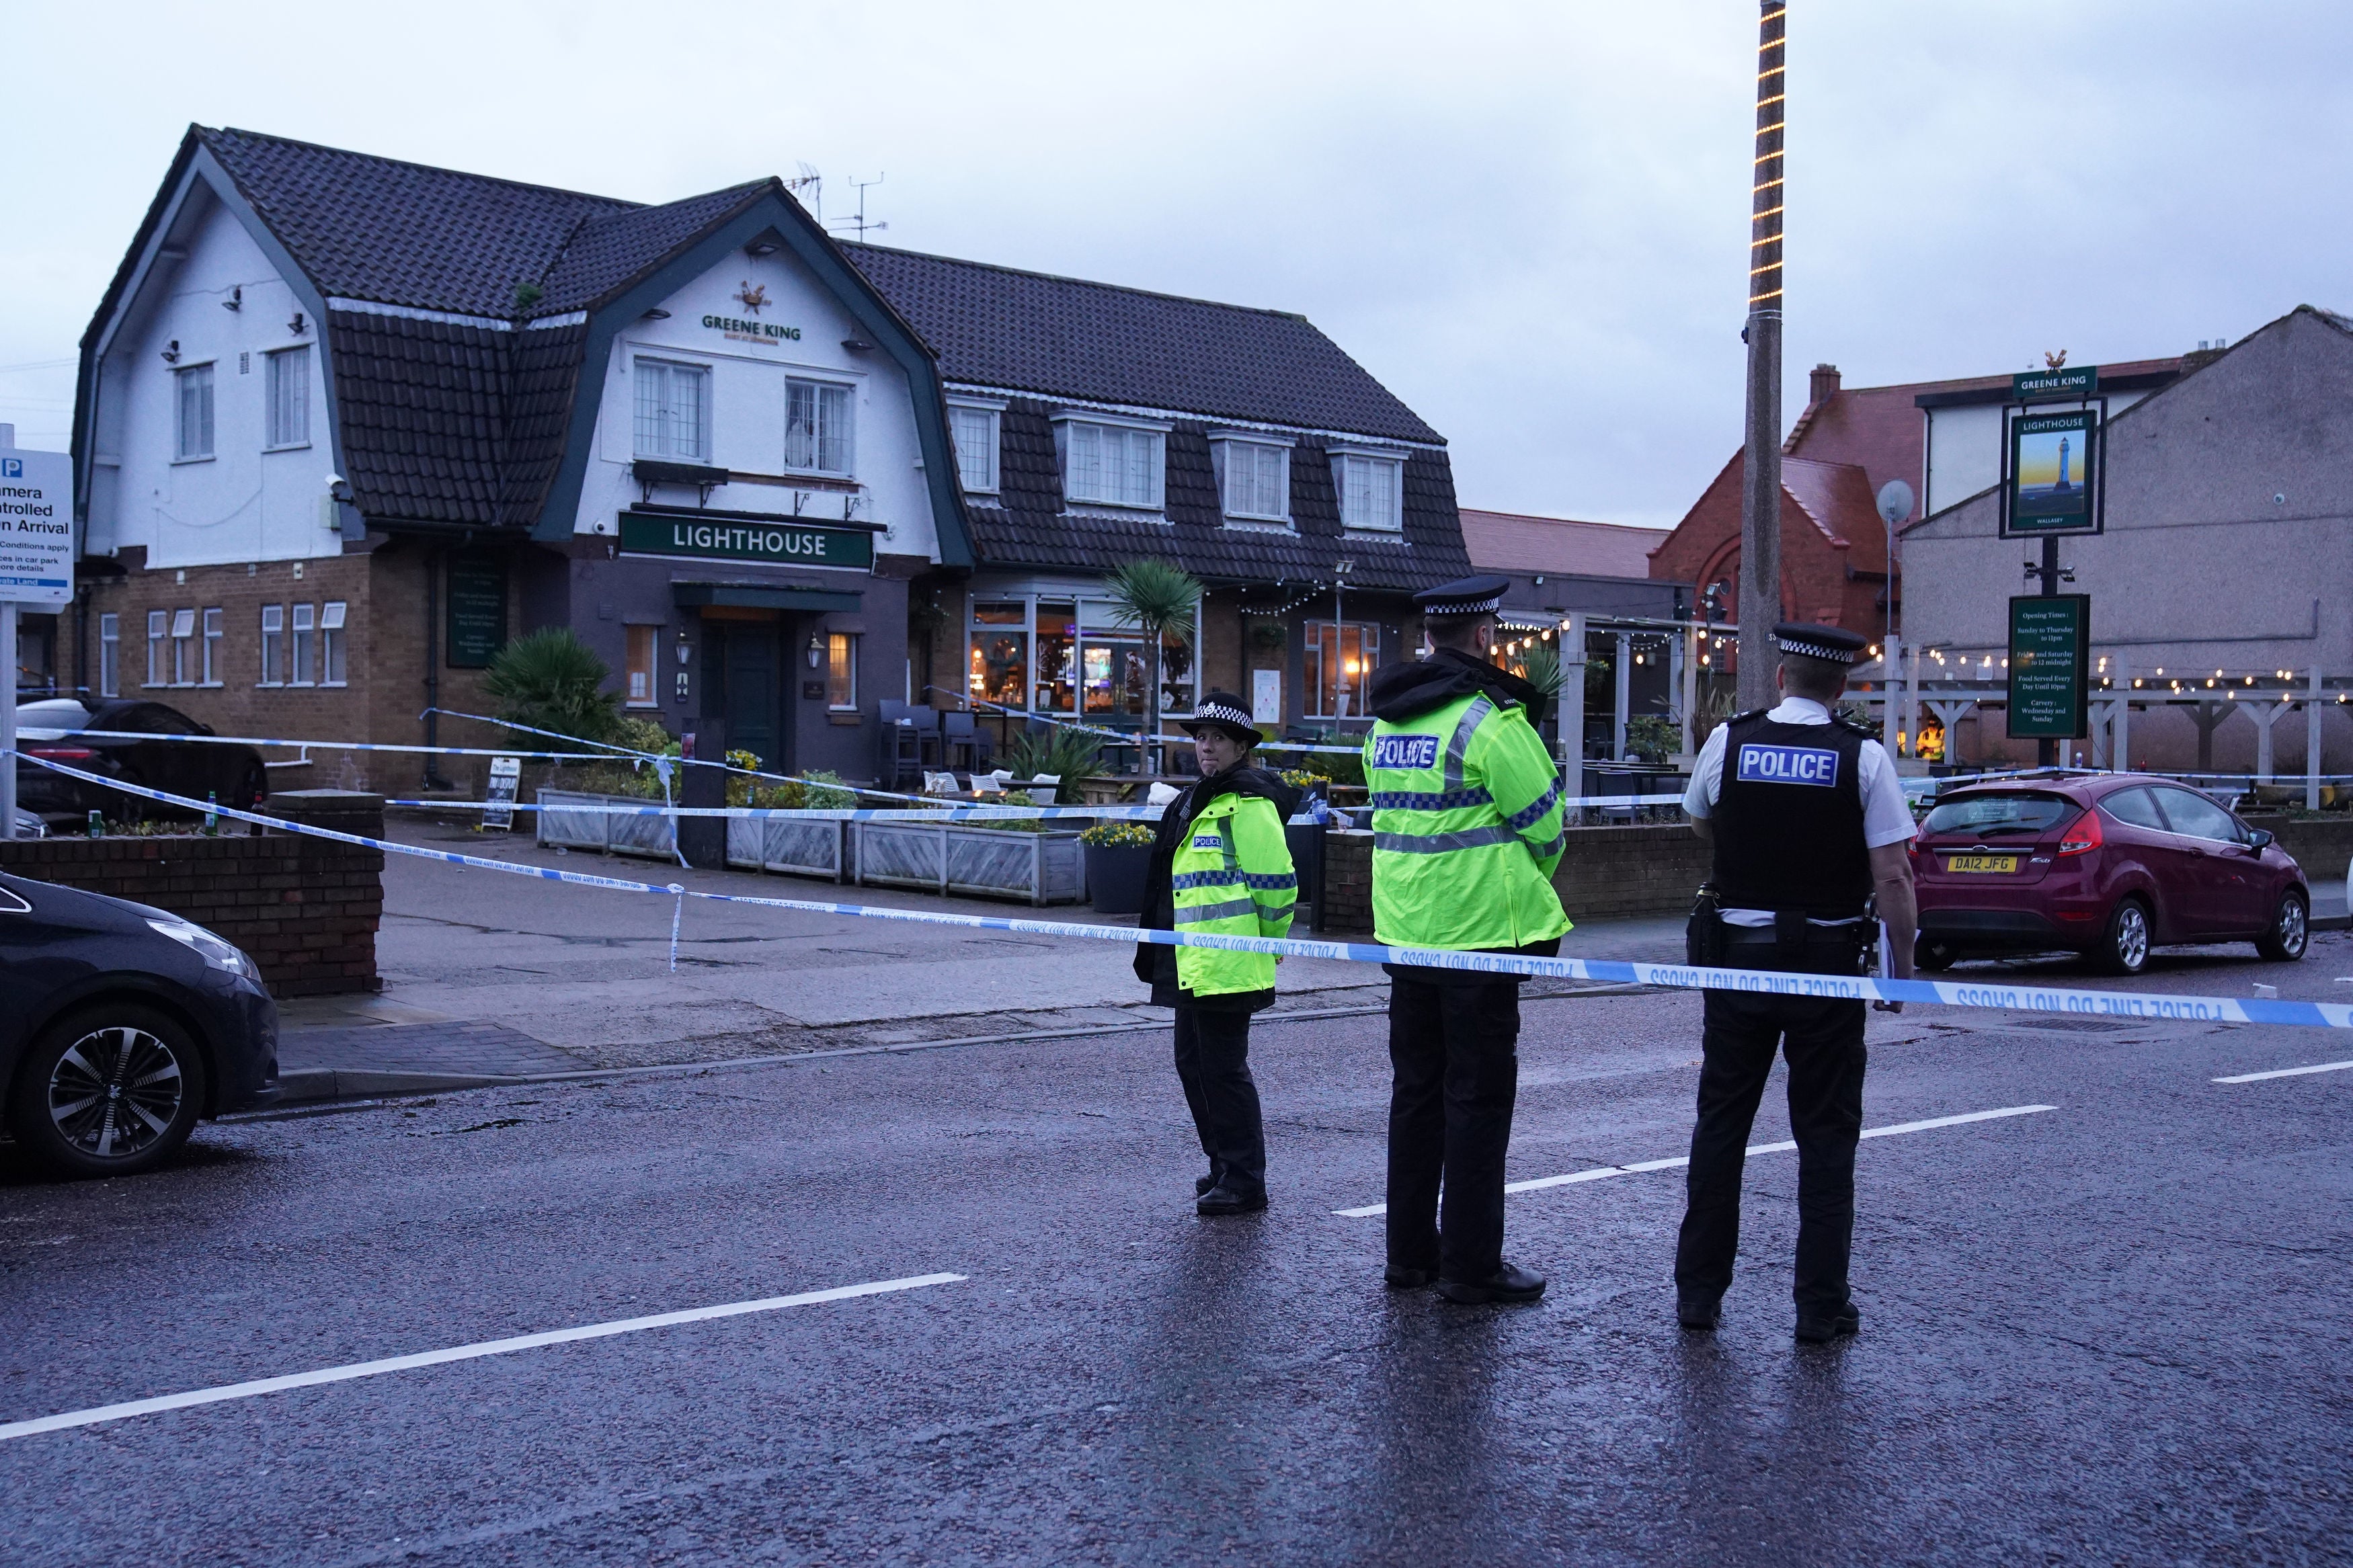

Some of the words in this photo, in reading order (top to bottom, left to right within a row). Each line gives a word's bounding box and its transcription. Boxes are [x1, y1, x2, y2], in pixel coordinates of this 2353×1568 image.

[702, 315, 760, 335] GREENE
[764, 324, 801, 341] KING
[2021, 378, 2059, 390] GREENE
[2061, 376, 2086, 386] KING
[2023, 417, 2083, 431] LIGHTHOUSE
[0, 487, 42, 499] mera
[0, 522, 11, 531] n
[17, 520, 68, 534] Arrival
[0, 540, 45, 550] Conditions
[47, 544, 69, 552] apply
[674, 524, 826, 556] LIGHTHOUSE
[17, 578, 38, 586] Land
[2022, 612, 2047, 620] Opening
[2046, 626, 2073, 634] Thursday
[2054, 675, 2071, 683] Every
[1375, 737, 1435, 764] POLICE
[1743, 750, 1833, 780] POLICE
[1195, 837, 1221, 845] POLICE
[1955, 857, 1982, 870] DA12
[1984, 857, 2009, 870] JFG
[1494, 958, 1523, 974] LINE
[1527, 960, 1574, 978] POLICE
[1765, 977, 1798, 996] LINE
[1802, 979, 1860, 999] POLICE
[2025, 993, 2060, 1012] NOT
[2100, 997, 2143, 1016] LINE
[2149, 999, 2223, 1021] POLICE
